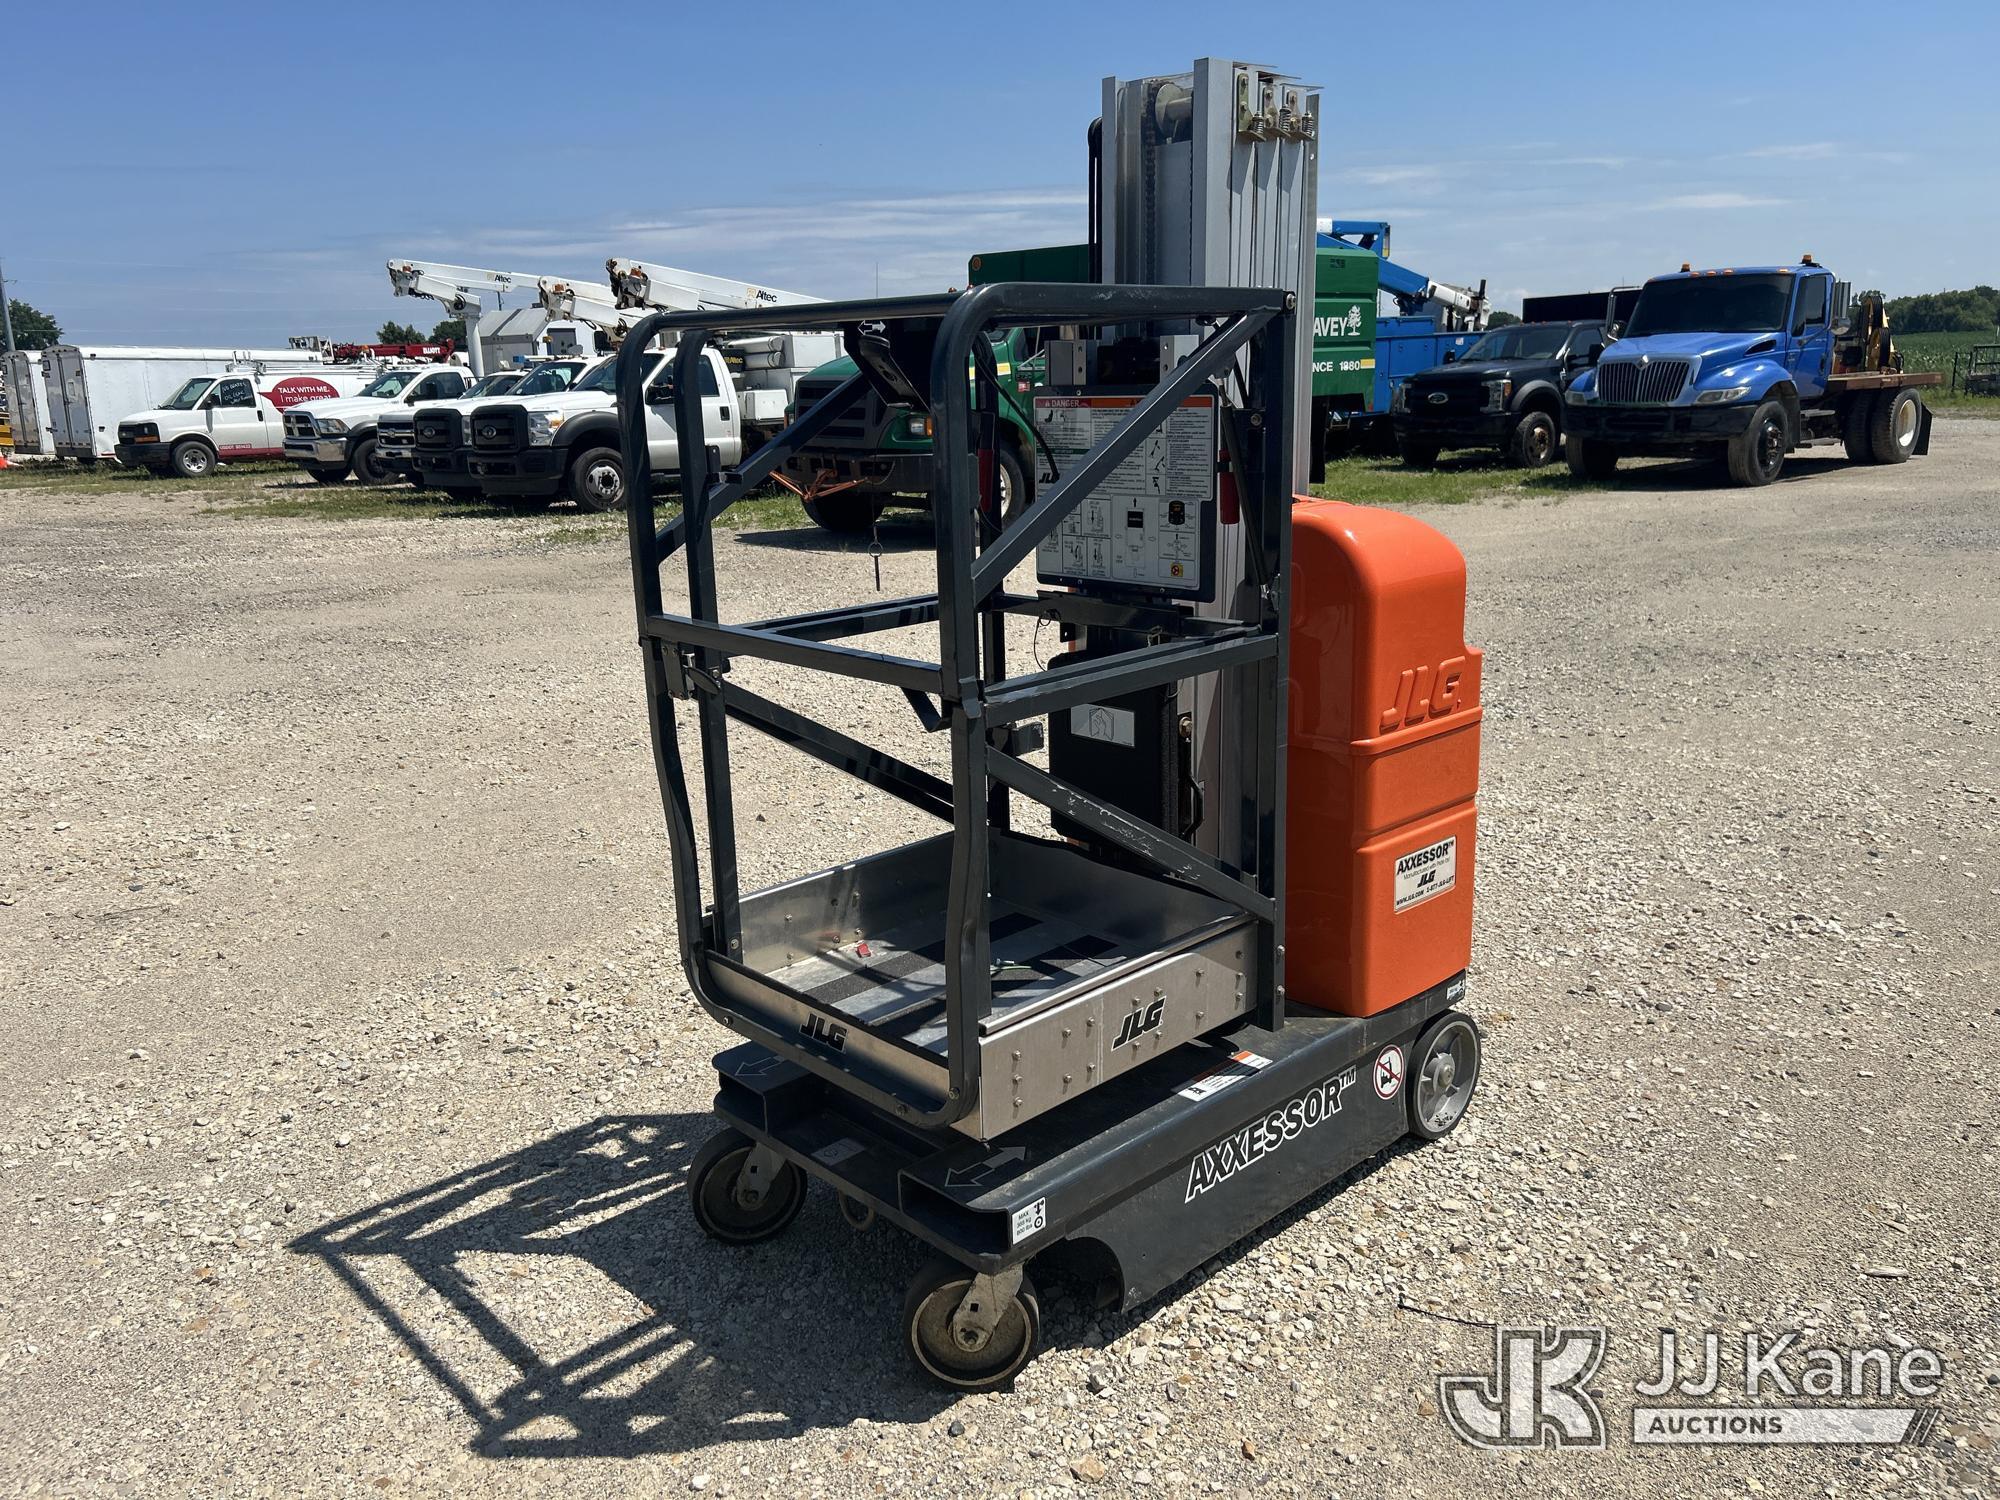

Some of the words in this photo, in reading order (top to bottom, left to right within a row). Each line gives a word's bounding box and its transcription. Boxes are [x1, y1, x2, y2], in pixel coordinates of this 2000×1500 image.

[495, 274, 511, 284] Altec
[756, 290, 777, 302] Altec
[1313, 317, 1348, 337] AVEY
[278, 386, 297, 394] TALK
[316, 385, 330, 393] ME.
[280, 394, 284, 403] I
[285, 394, 309, 403] make
[1051, 399, 1080, 407] DANGER
[1379, 656, 1465, 736] JLG
[1416, 869, 1437, 888] JLG
[1111, 996, 1166, 1051] JLG
[799, 1011, 848, 1053] JLG
